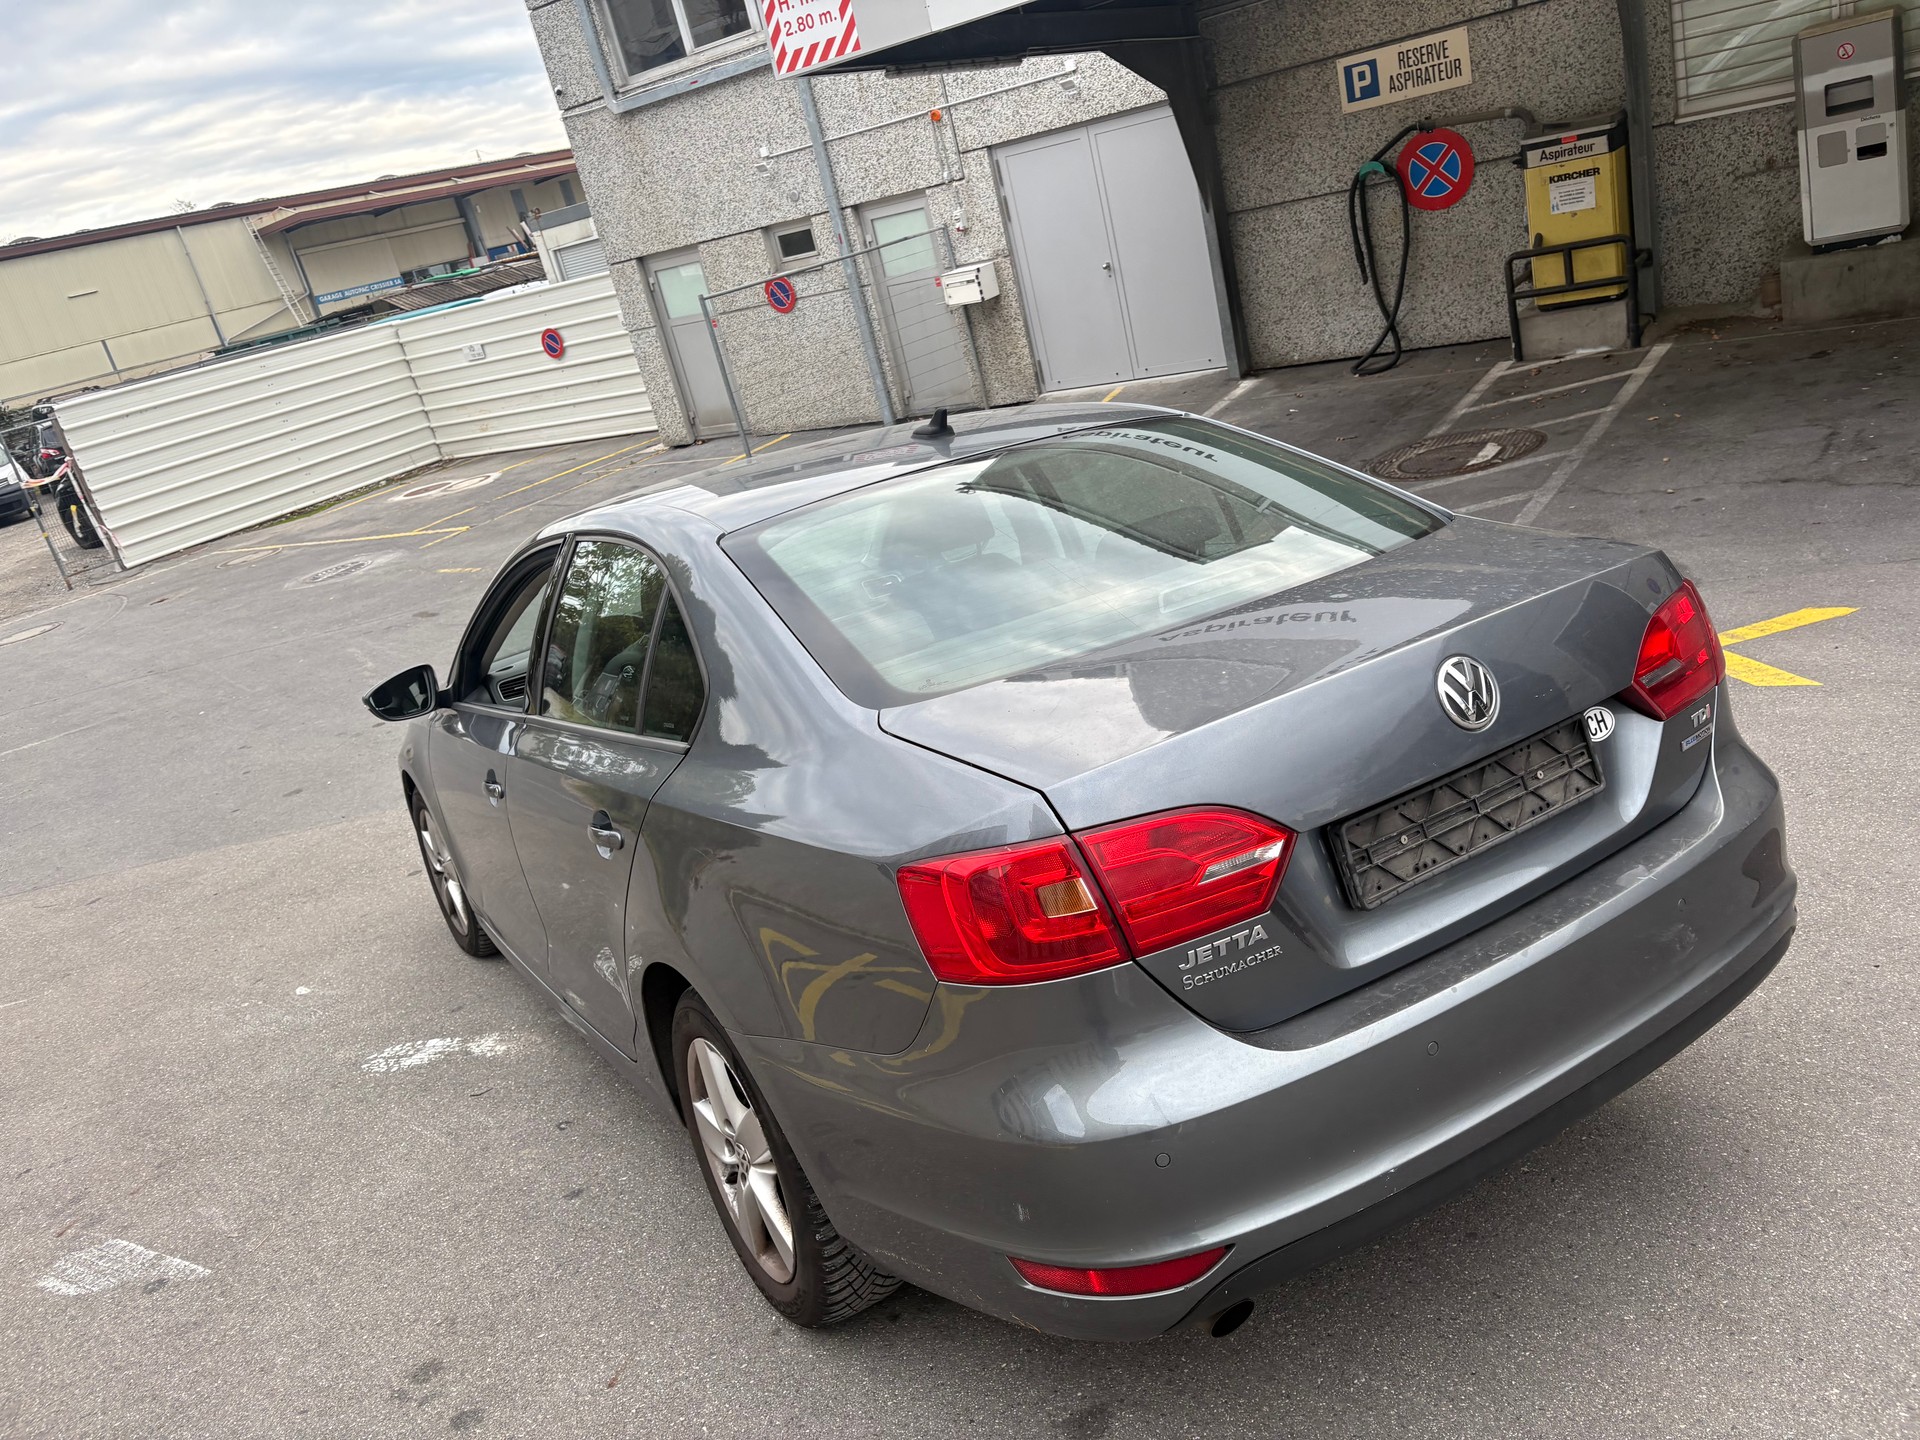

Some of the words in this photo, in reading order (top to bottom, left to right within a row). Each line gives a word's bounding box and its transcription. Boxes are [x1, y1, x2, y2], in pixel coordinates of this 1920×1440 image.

[783, 13, 815, 37] 2.80
[818, 10, 838, 26] m.
[1397, 39, 1450, 70] RESERVE
[1351, 64, 1372, 99] P
[1389, 58, 1463, 94] ASPIRATEUR
[1539, 142, 1596, 162] Aspirateur
[319, 293, 343, 302] GARAGE
[344, 286, 370, 297] AUTOPAC
[370, 280, 394, 291] CRISSIER
[1586, 710, 1609, 736] CH
[1690, 703, 1711, 728] TDI
[1178, 924, 1269, 971] JETTA
